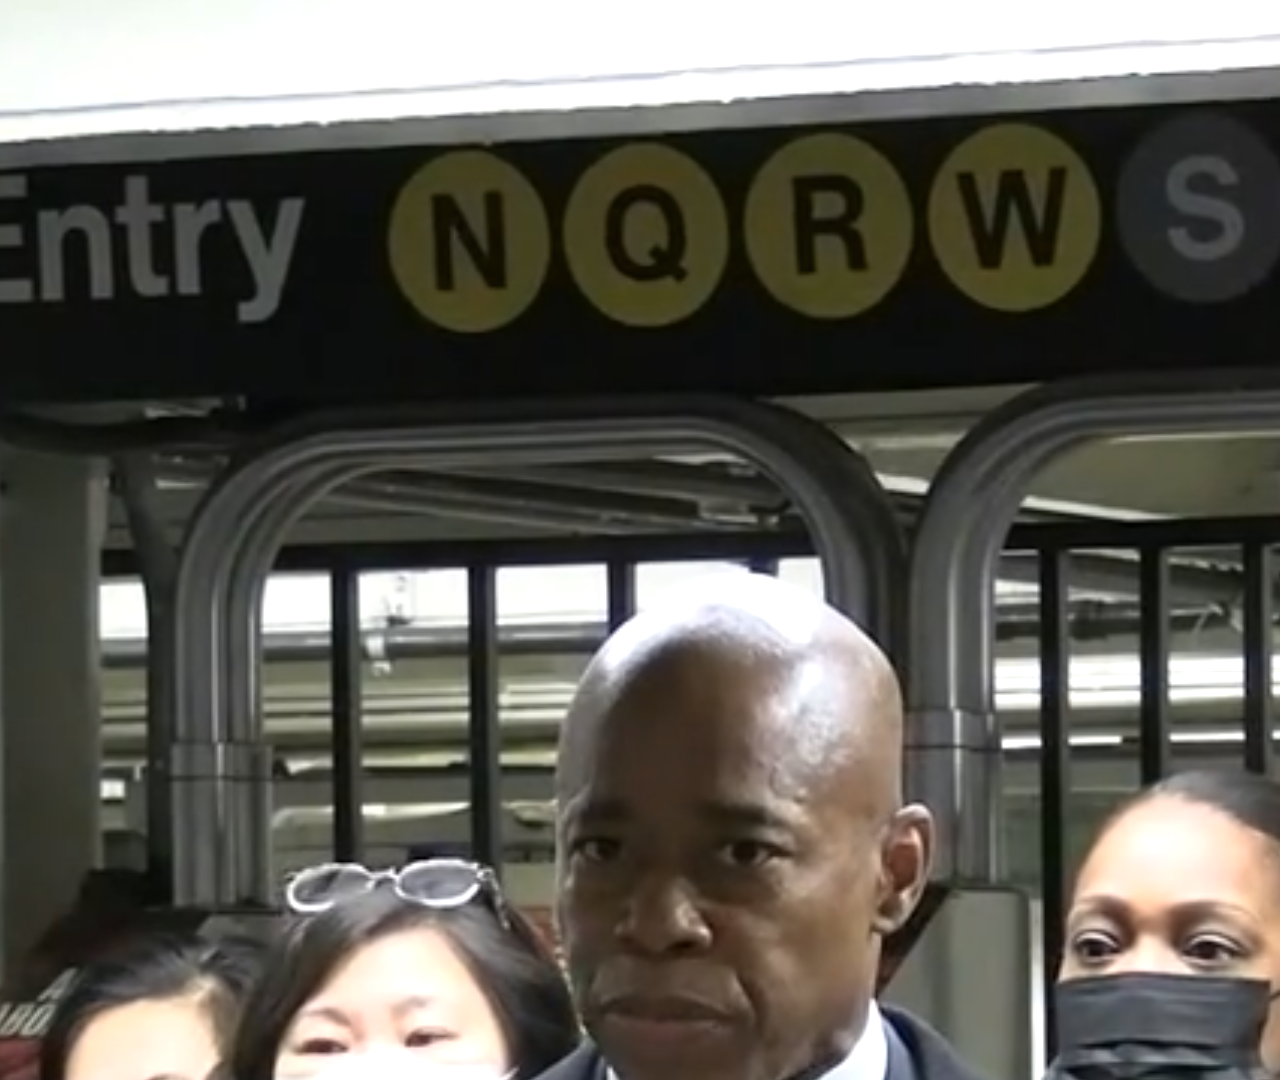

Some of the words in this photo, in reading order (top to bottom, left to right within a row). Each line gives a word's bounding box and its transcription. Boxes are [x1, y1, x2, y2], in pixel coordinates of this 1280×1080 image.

[429, 189, 509, 292] N
[603, 183, 689, 284] Q
[790, 172, 869, 276] R
[956, 165, 1068, 271] W
[1163, 153, 1246, 262] S
